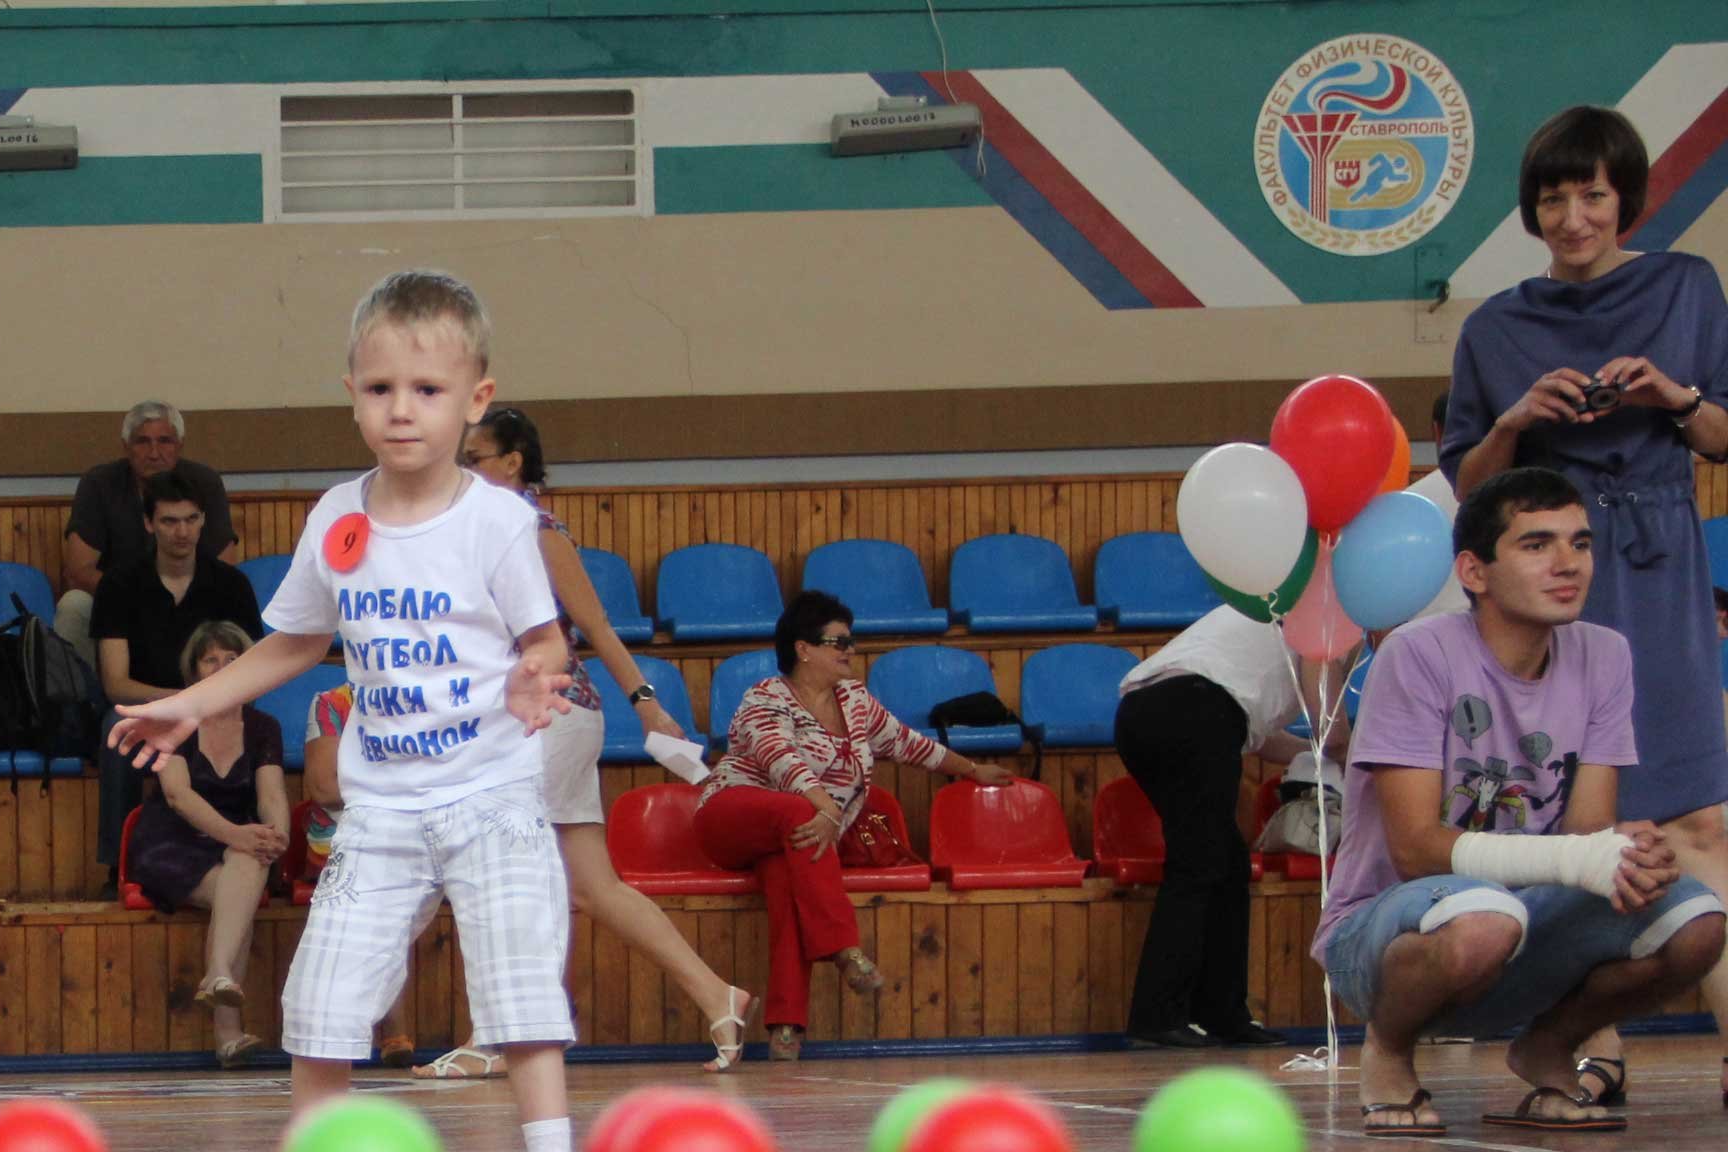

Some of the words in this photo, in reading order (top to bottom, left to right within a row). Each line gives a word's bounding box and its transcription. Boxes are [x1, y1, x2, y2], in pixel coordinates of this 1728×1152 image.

[1258, 79, 1295, 207] ФАКУЛЬТЕТ
[1436, 83, 1470, 201] КУЛЬТУРЫ
[1349, 122, 1450, 136] СТАВРОПОЛЬ
[1335, 168, 1358, 180] СГУ
[341, 531, 356, 554] 9
[338, 587, 452, 621] ЛЮБЛЮ
[350, 682, 427, 716] АЧКИ
[449, 677, 471, 707] И
